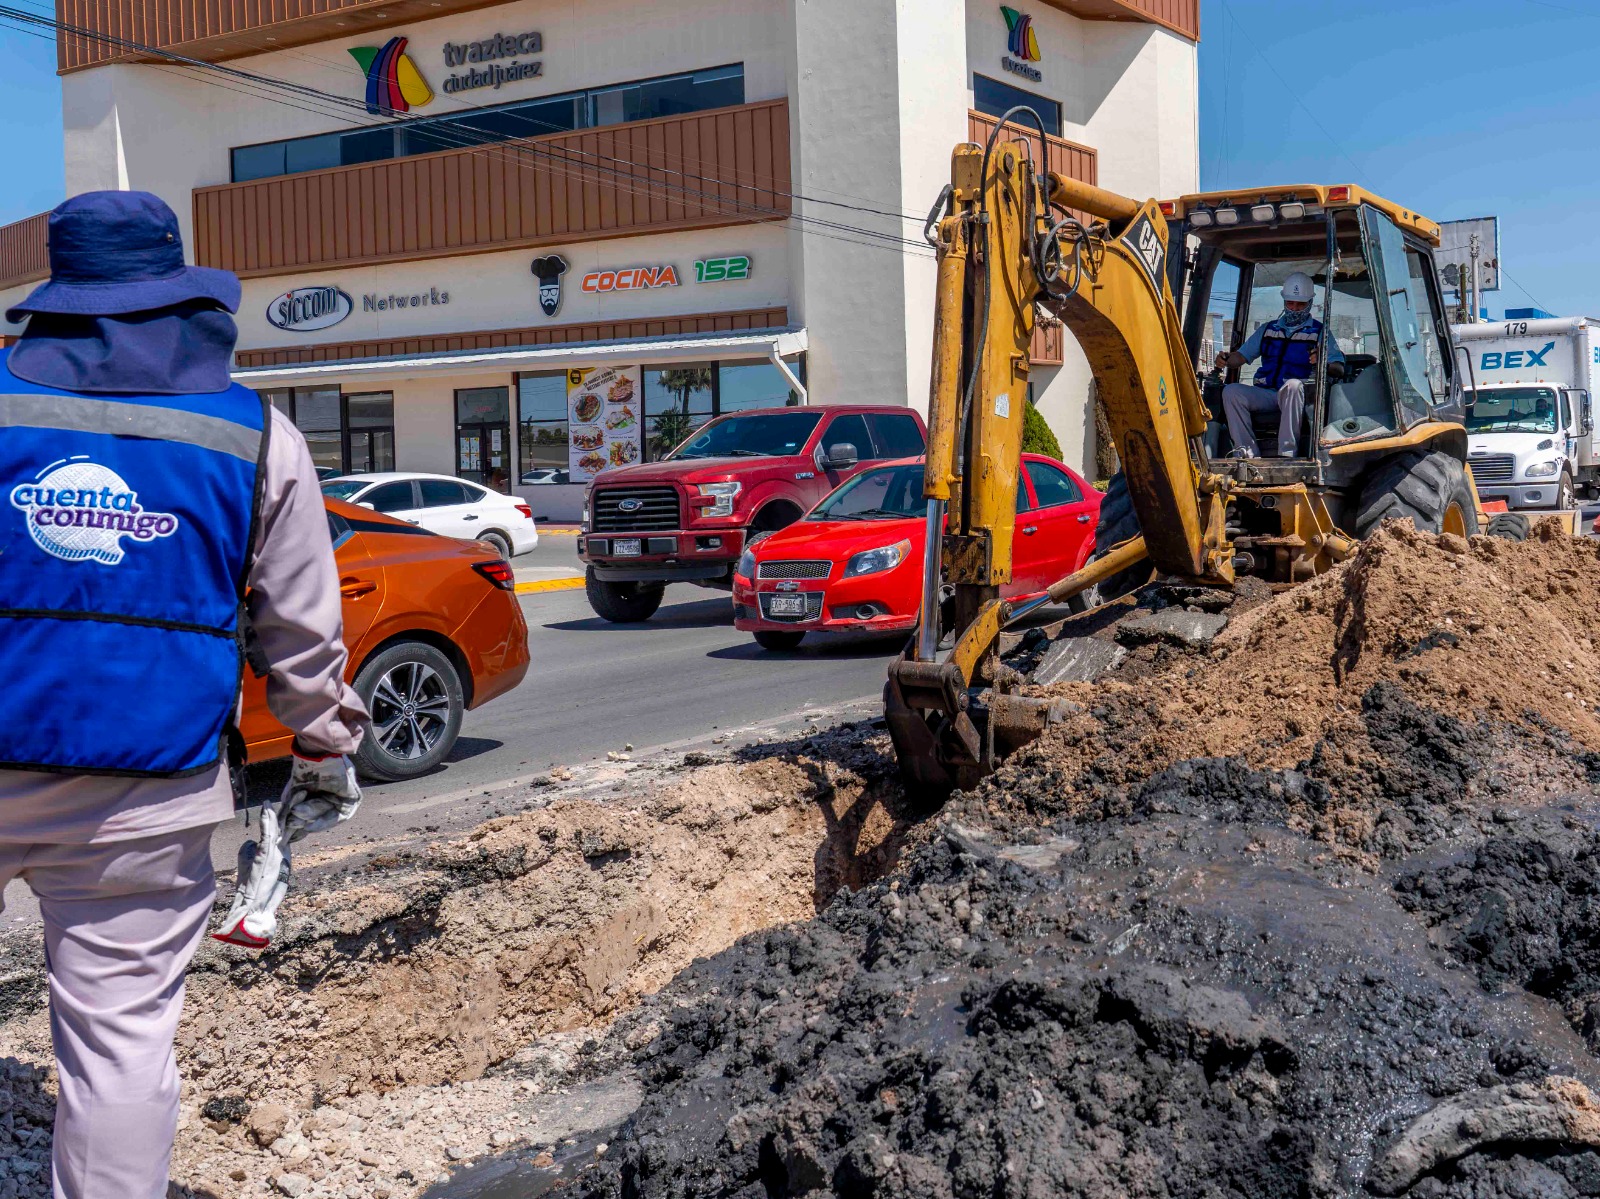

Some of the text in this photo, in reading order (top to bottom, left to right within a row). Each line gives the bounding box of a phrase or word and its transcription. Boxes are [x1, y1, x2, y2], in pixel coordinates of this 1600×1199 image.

[442, 61, 543, 93] ciudad juárez
[1139, 220, 1164, 275] CAT
[580, 255, 751, 294] COCINA 152
[362, 287, 451, 313] Networks
[1504, 322, 1528, 336] 179
[1480, 343, 1554, 371] BEX
[13, 486, 134, 512] cuenta
[35, 505, 176, 539] conmigo
